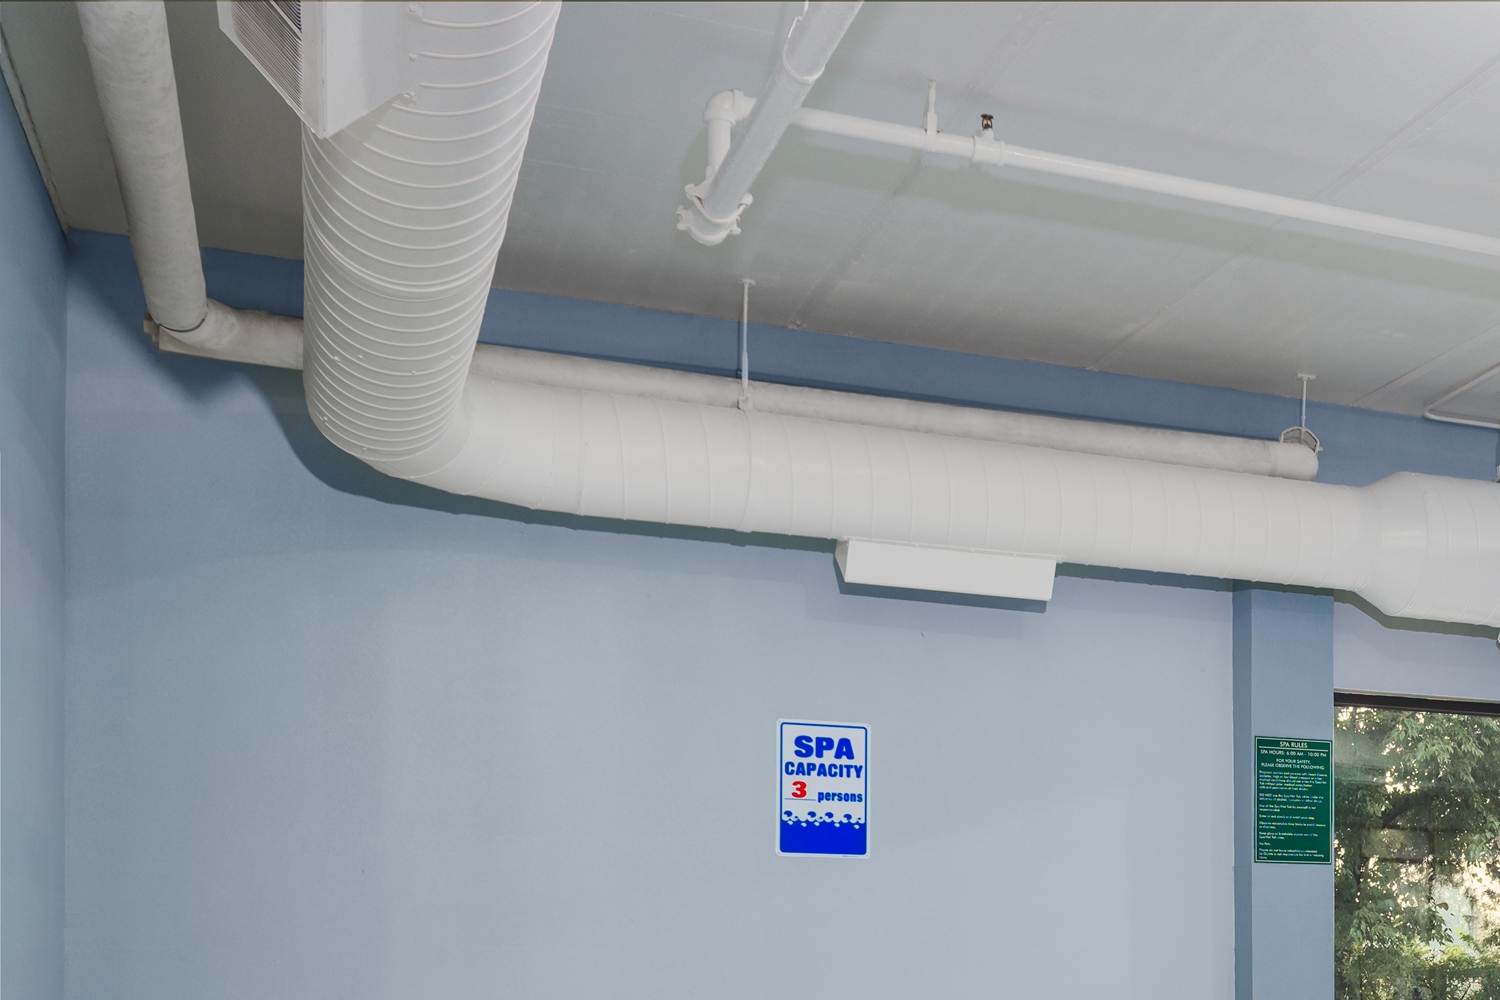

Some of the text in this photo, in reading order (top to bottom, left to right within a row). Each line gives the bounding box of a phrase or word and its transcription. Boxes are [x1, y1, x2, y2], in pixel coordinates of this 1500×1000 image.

[794, 735, 855, 760] SPA
[784, 762, 863, 778] CAPACITY
[792, 780, 863, 803] 3 persons
